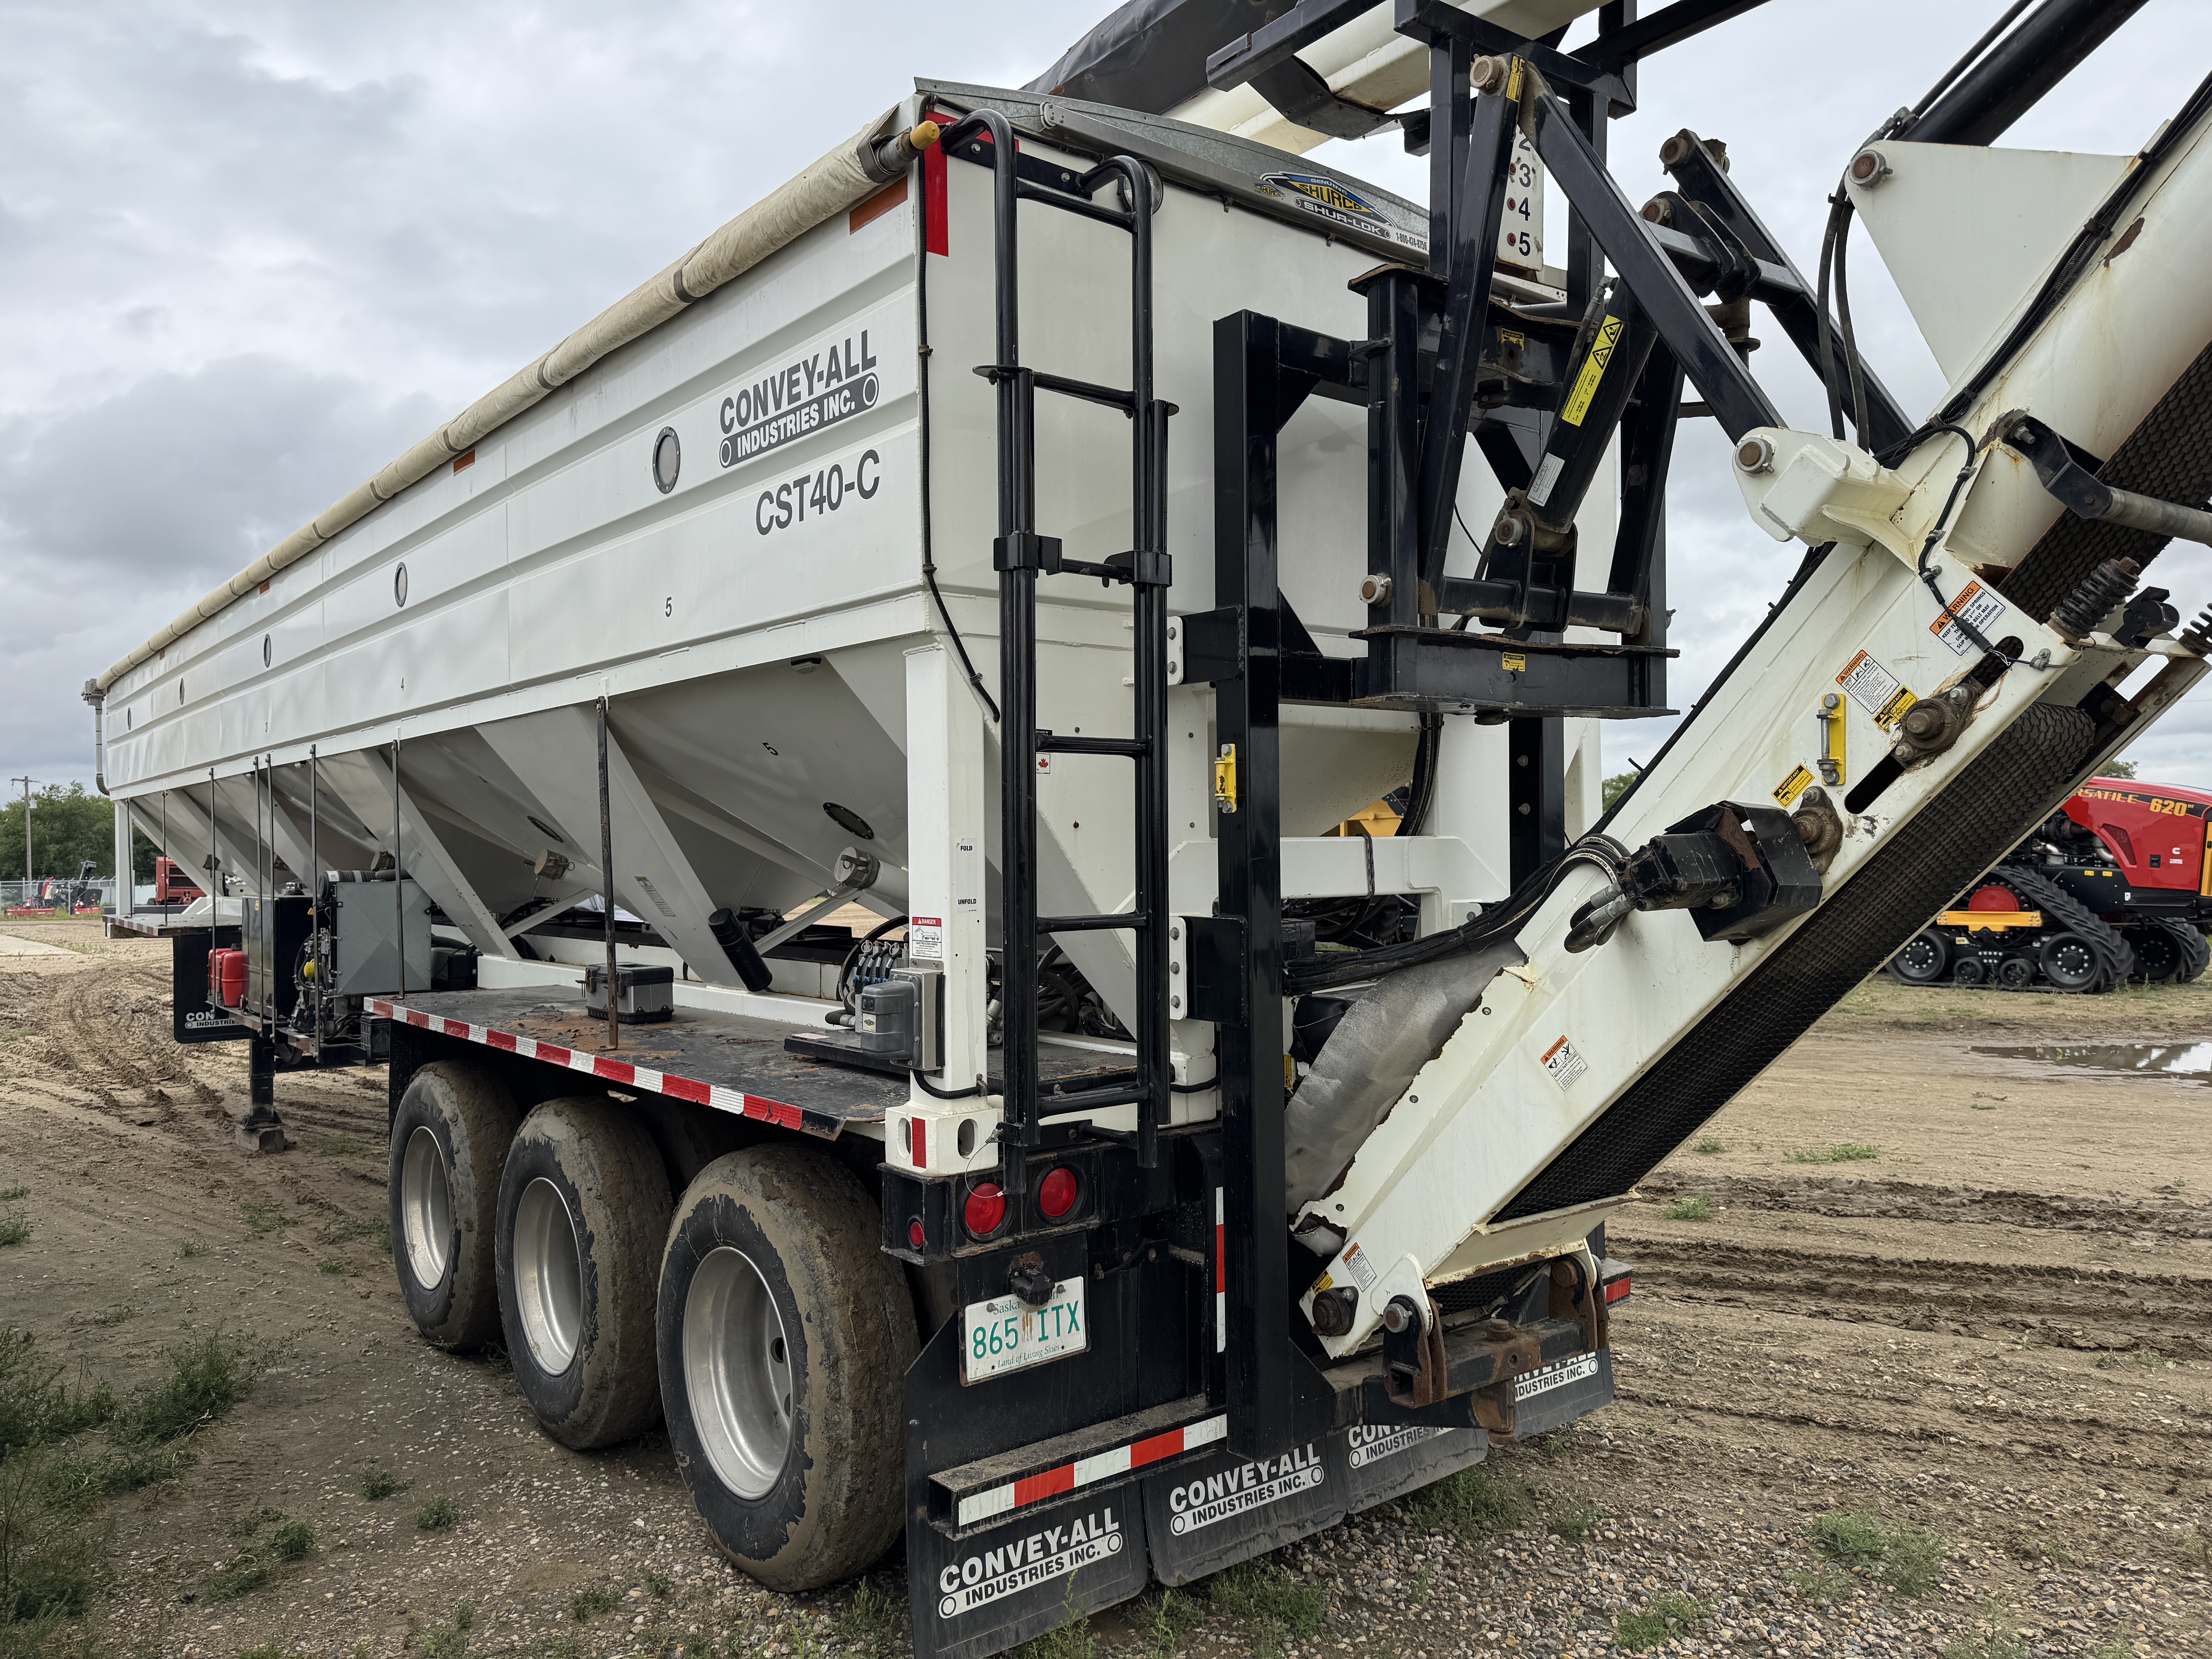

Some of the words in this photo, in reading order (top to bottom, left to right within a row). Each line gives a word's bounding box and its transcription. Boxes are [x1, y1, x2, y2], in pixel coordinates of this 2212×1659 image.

[1310, 178, 1348, 195] GENUINE
[1519, 163, 1531, 187] 3
[1298, 184, 1362, 211] SHURCO
[1519, 197, 1530, 221] 4
[1304, 201, 1382, 235] SHUR-LOK
[1396, 232, 1427, 251] 1-800-474-8756
[1519, 231, 1530, 256] 5
[720, 330, 876, 434] CONVEY-ALL
[737, 403, 819, 458] INDUSTRIES
[824, 389, 855, 421] INC.
[756, 449, 880, 535] CST40-C
[665, 597, 672, 617] 5
[1942, 628, 1951, 639] KEEP
[1950, 607, 1971, 629] TEONING
[1970, 591, 1985, 608] SPRINGS
[1973, 612, 1982, 623] BELT
[1981, 604, 1990, 614] MAY
[1956, 639, 1965, 649] SLIP
[1978, 604, 1999, 625] OPERATION
[1843, 653, 1864, 675] WARNING
[401, 677, 404, 691] 4
[1883, 692, 1903, 714] IMPORTANT
[762, 742, 778, 756] 5
[1782, 769, 1800, 789] IMPORTANT
[2075, 788, 2139, 804] RSATILE
[2150, 798, 2187, 816] 620
[1547, 1039, 1565, 1057] WARNING
[973, 1316, 1018, 1359] 865
[1037, 1300, 1080, 1342] ITX
[998, 1358, 1014, 1368] Land
[1016, 1353, 1023, 1364] of
[1024, 1348, 1042, 1360] Living
[1516, 1372, 1564, 1398] DUSTRIES
[1567, 1365, 1585, 1380] INC.
[1365, 1427, 1430, 1460] INDUSTRIES
[1170, 1443, 1320, 1513] CONVEY-ALL
[1192, 1484, 1275, 1525] INDUSTRIES
[1279, 1475, 1307, 1494] INC.
[940, 1507, 1119, 1593] CONVEY-ALL
[965, 1556, 1065, 1606] INDUSTRIES
[1069, 1544, 1101, 1566] INC.
